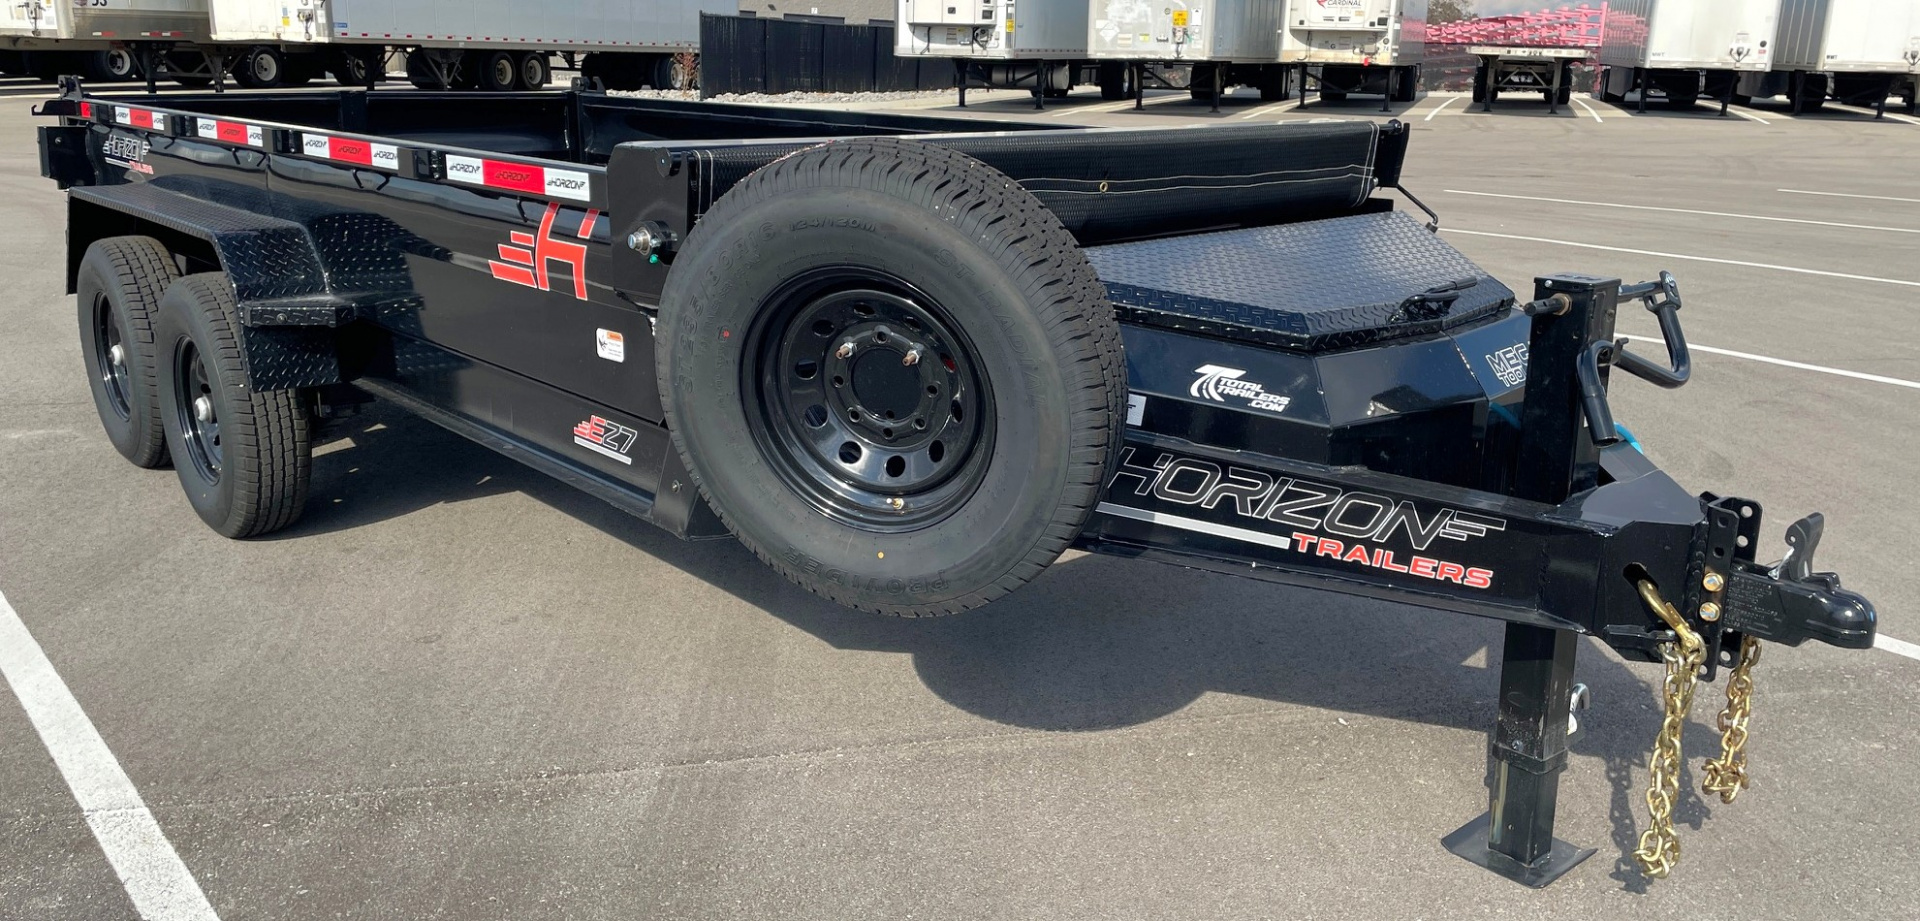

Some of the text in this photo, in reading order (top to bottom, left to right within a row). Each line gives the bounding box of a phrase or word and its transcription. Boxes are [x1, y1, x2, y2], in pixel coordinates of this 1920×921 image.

[449, 162, 586, 191] HORIZON HORIZON HORIZON
[1217, 385, 1291, 405] TRAILERS
[1220, 377, 1265, 393] TOTAL
[1247, 400, 1286, 412] .COM
[574, 414, 638, 454] E27
[1107, 446, 1506, 551] HORIZON
[1292, 531, 1494, 588] TRAILERS
